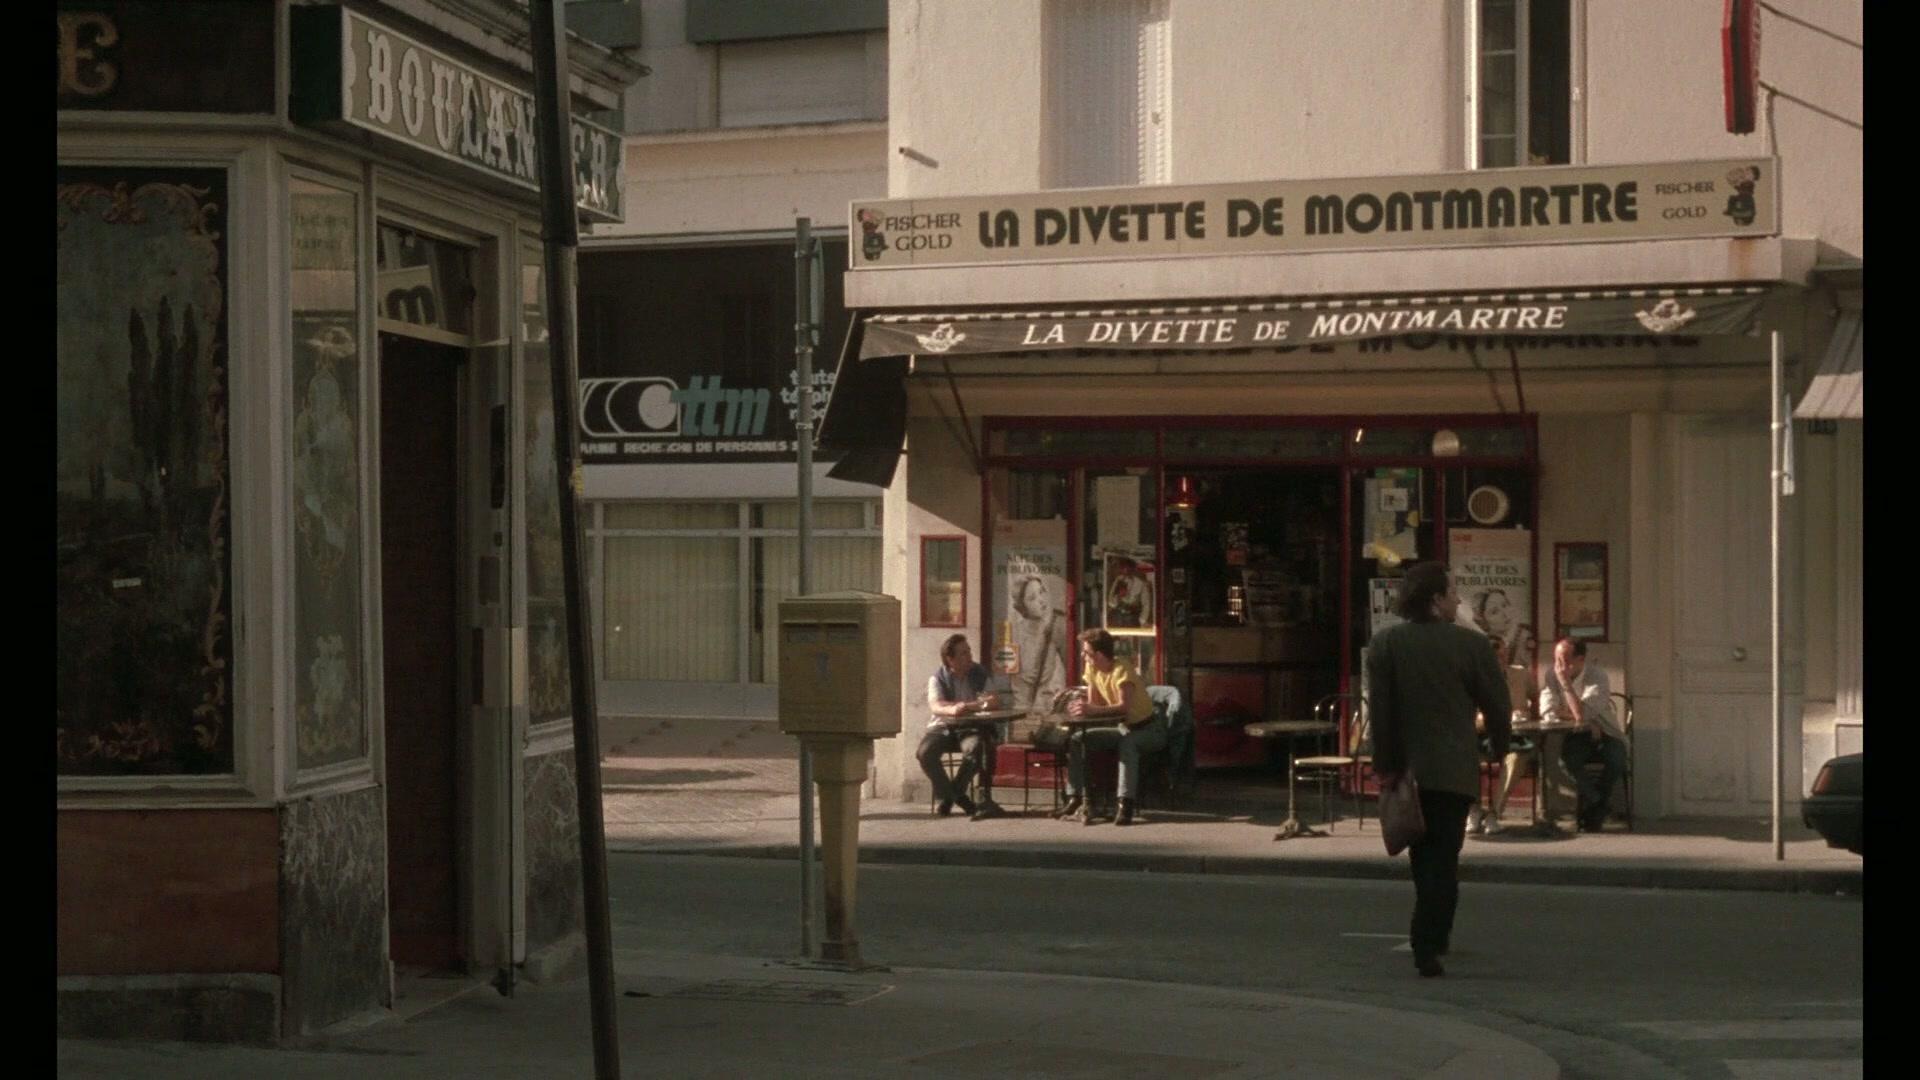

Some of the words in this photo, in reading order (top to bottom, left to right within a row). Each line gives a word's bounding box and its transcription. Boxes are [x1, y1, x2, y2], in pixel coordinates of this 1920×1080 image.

[368, 30, 610, 210] BOULANER
[1655, 181, 1715, 196] FISCHER
[979, 209, 1019, 248] LA
[1034, 201, 1205, 246] DIVETTE
[1227, 196, 1284, 238] DE
[1305, 182, 1637, 234] MONTMARTRE
[1662, 204, 1708, 220] GOLD
[885, 213, 961, 233] FISCHER
[896, 234, 952, 252] GOLD
[1022, 323, 1065, 346] LA
[1087, 319, 1238, 345] DIVETTE
[1253, 321, 1290, 341] DE
[1308, 305, 1569, 339] MONTMARTRE
[671, 375, 770, 436] ttm
[695, 442, 712, 453] DE
[1463, 564, 1491, 575] NUIT
[1495, 564, 1519, 575] DES
[1455, 575, 1527, 586] PUBLIVORES
